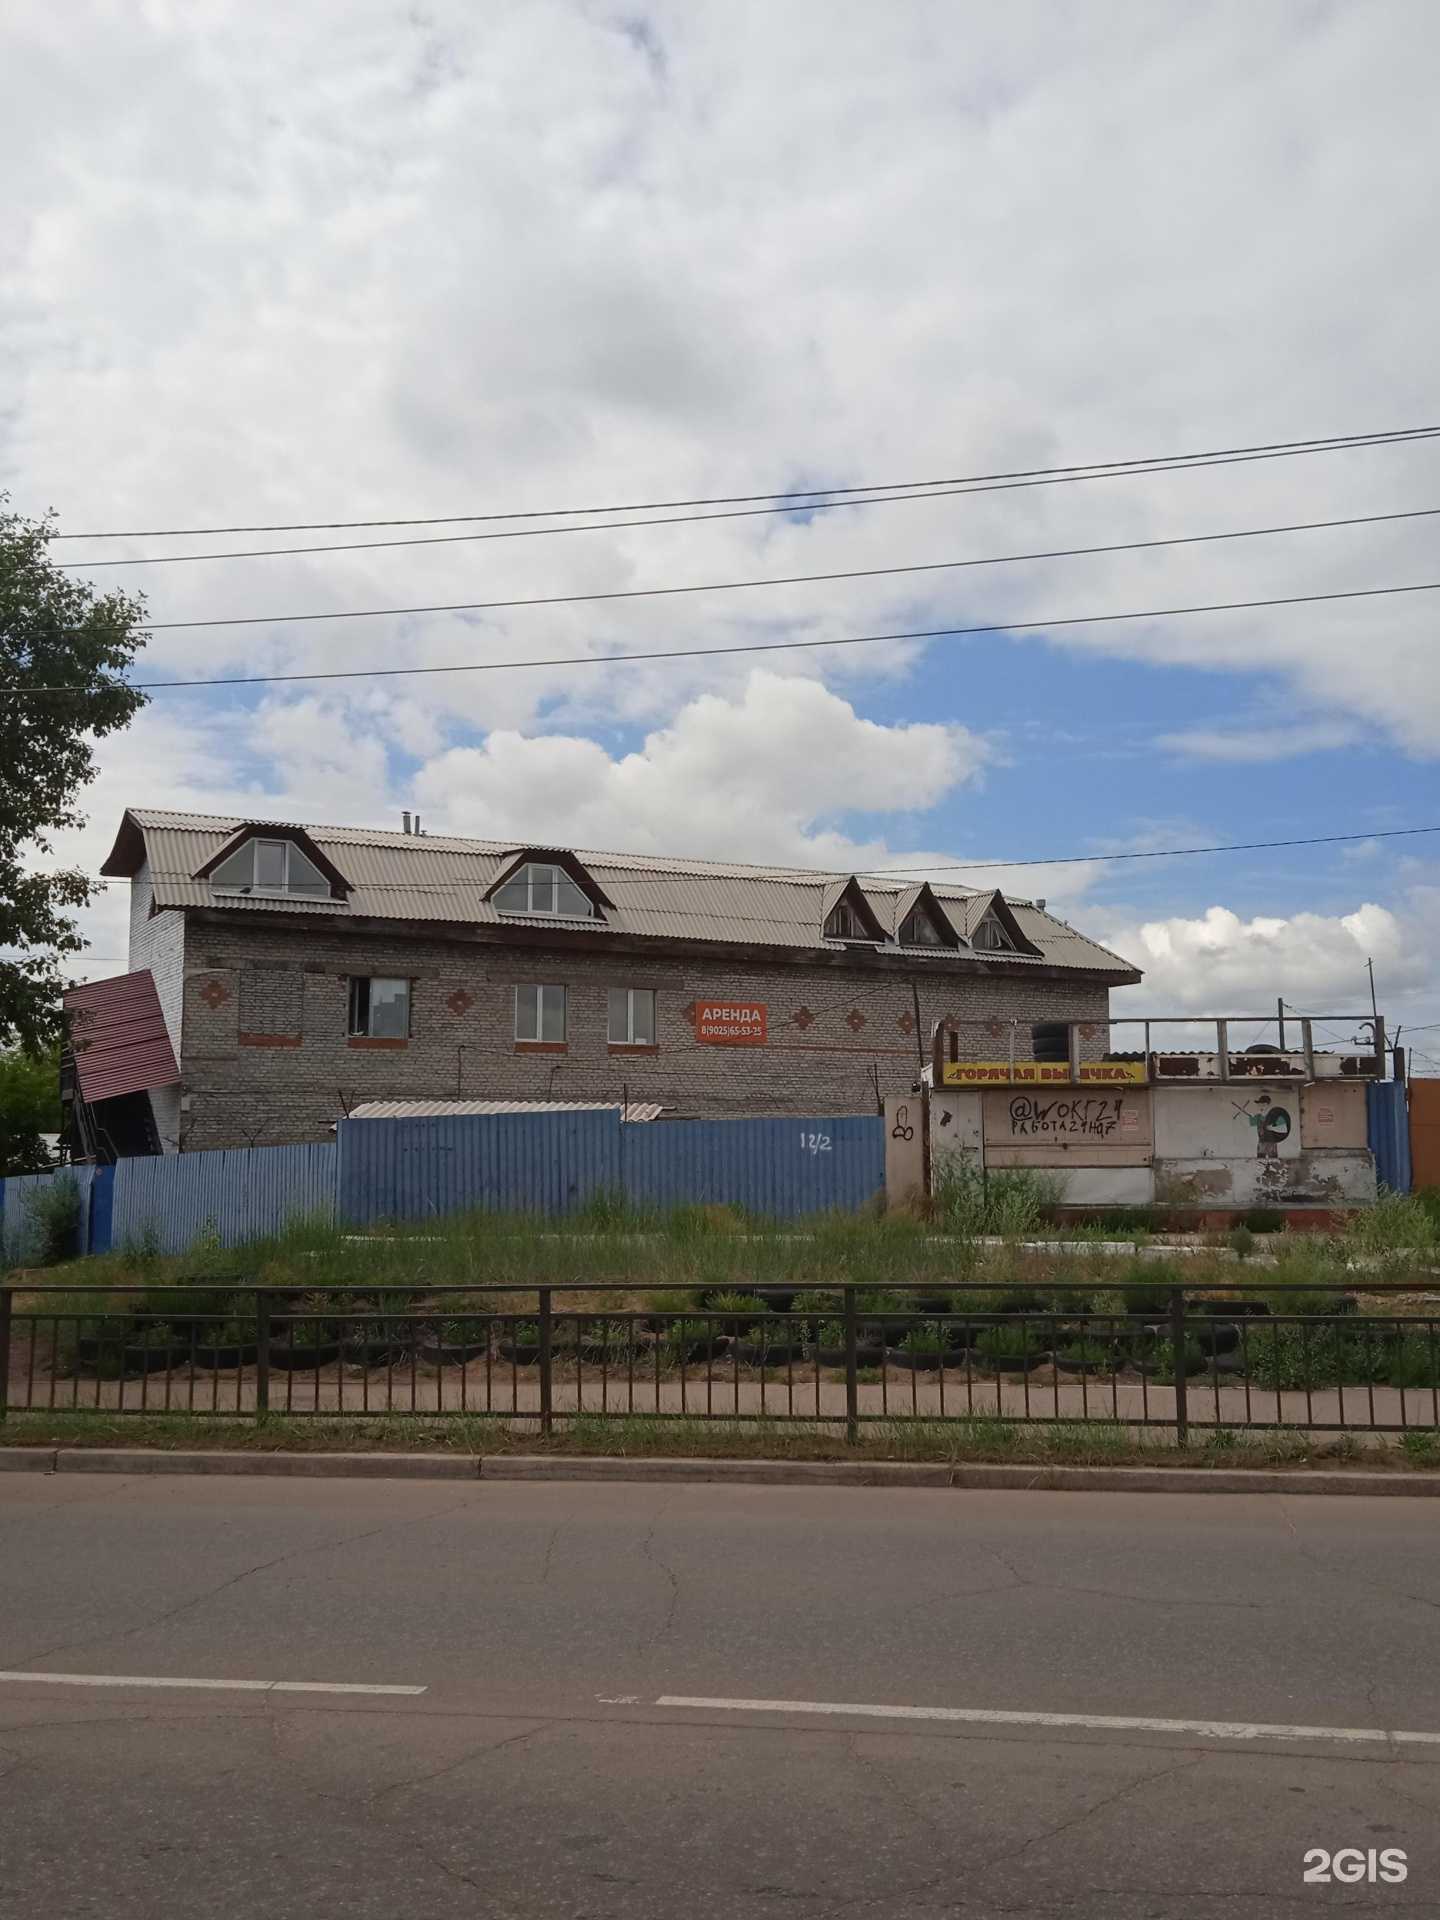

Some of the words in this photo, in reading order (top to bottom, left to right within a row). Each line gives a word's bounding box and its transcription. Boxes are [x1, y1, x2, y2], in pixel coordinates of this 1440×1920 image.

[702, 1008, 761, 1023] АРЕНДА
[956, 1068, 1035, 1080] ГОРЯЧАЯ
[1041, 1068, 1127, 1080] ВЫЕЧКА
